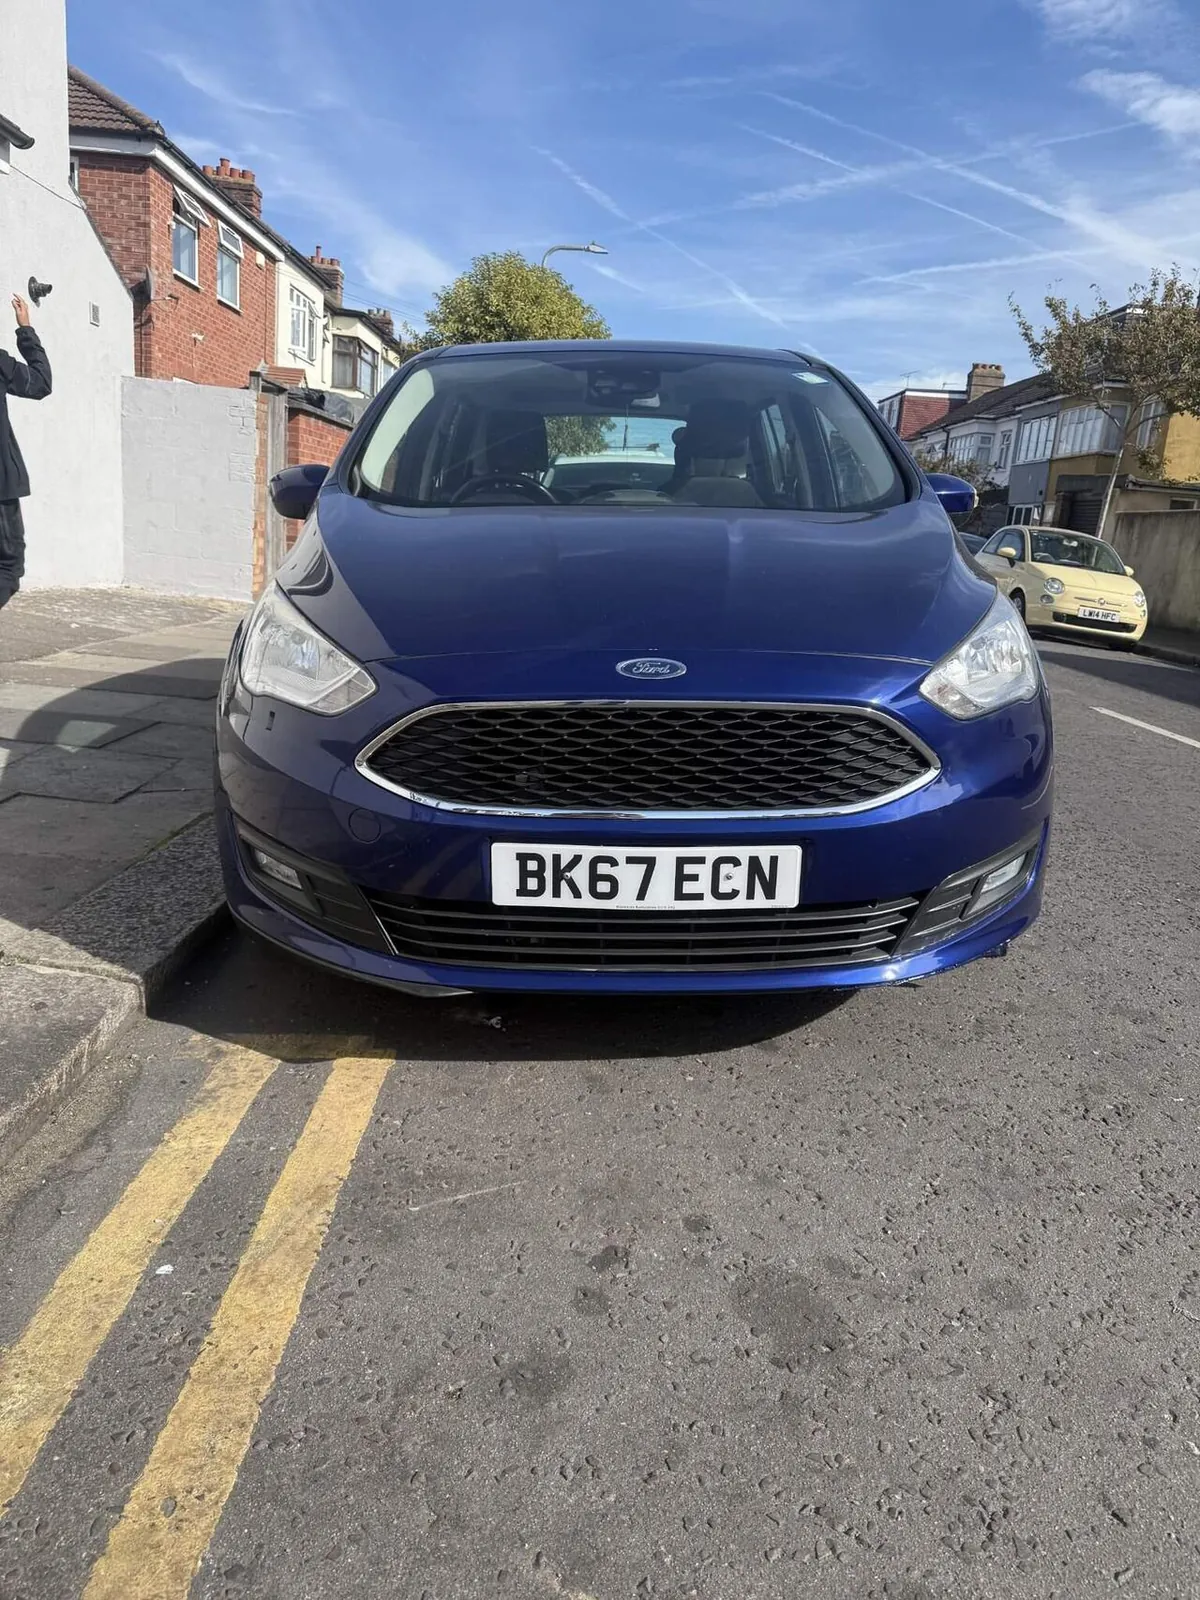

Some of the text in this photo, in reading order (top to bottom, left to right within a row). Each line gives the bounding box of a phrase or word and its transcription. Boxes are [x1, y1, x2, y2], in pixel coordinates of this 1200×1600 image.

[1100, 611, 1117, 621] HFC
[632, 661, 671, 674] Ford
[515, 852, 779, 901] BK67 ECN
